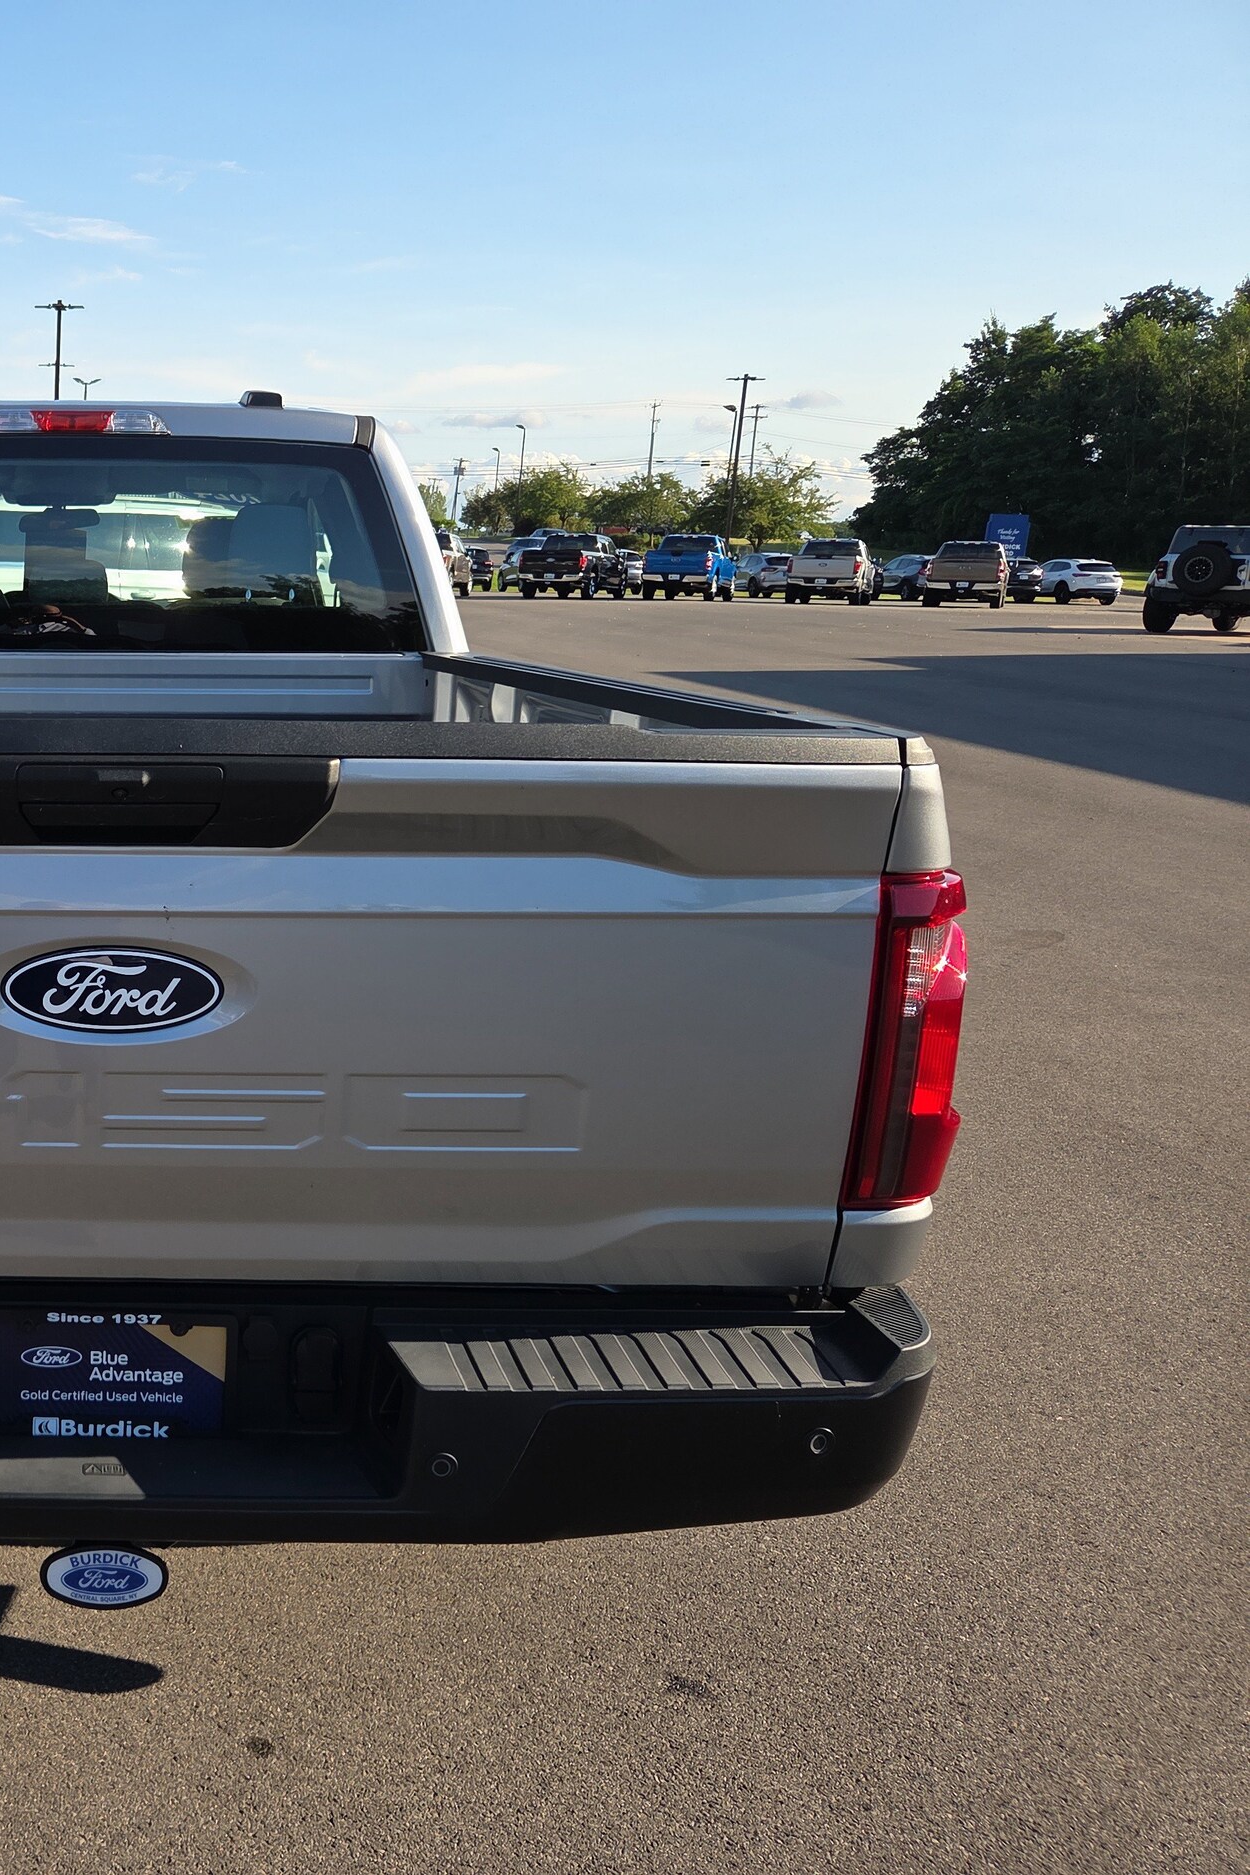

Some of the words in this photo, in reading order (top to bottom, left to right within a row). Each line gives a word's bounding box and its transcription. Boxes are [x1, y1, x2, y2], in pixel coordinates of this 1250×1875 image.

[42, 961, 182, 1017] Ford
[47, 1312, 104, 1324] Since
[112, 1313, 162, 1325] 1937
[32, 1349, 71, 1364] Ford
[90, 1350, 129, 1366] Blue
[89, 1367, 184, 1385] Advantage
[20, 1389, 49, 1401] Gold
[52, 1390, 103, 1402] Certified
[106, 1391, 137, 1402] Used
[140, 1392, 183, 1404] Vehicle
[60, 1419, 169, 1439] Burdick
[70, 1552, 142, 1569] BURDICK
[78, 1568, 131, 1590] Ford
[70, 1592, 98, 1601] CENTRAL
